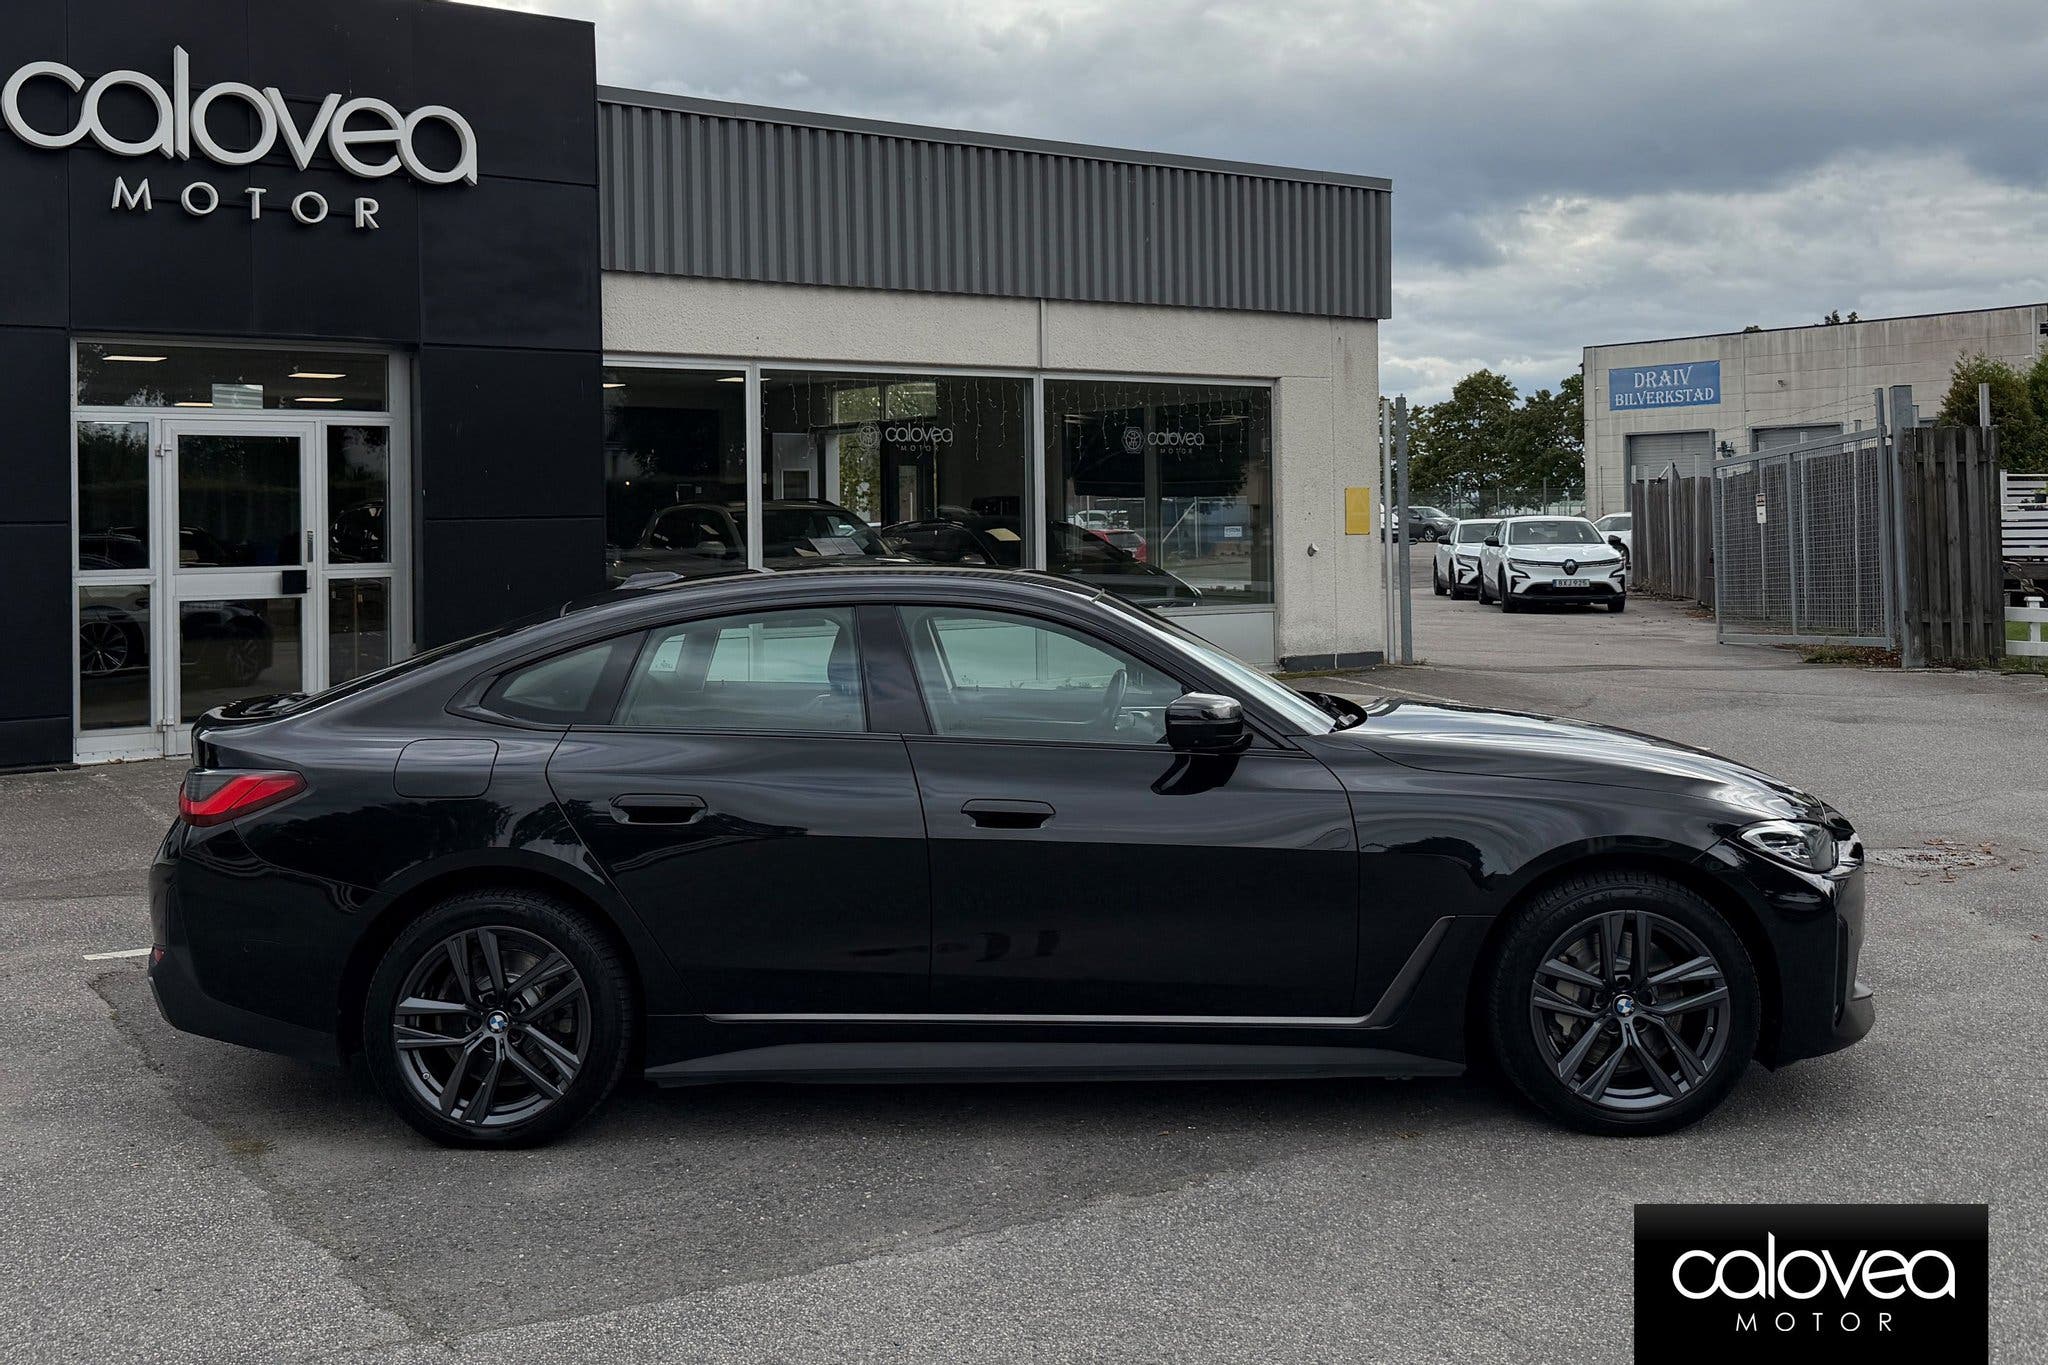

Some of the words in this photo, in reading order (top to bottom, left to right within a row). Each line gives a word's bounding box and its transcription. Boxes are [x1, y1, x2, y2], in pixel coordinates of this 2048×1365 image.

[1, 45, 478, 187] calovea
[111, 176, 380, 230] MOTOR
[1634, 366, 1693, 388] DRAIV
[1615, 387, 1714, 406] BILVERKSTAD
[885, 422, 953, 443] calovea
[1147, 427, 1205, 446] calovea
